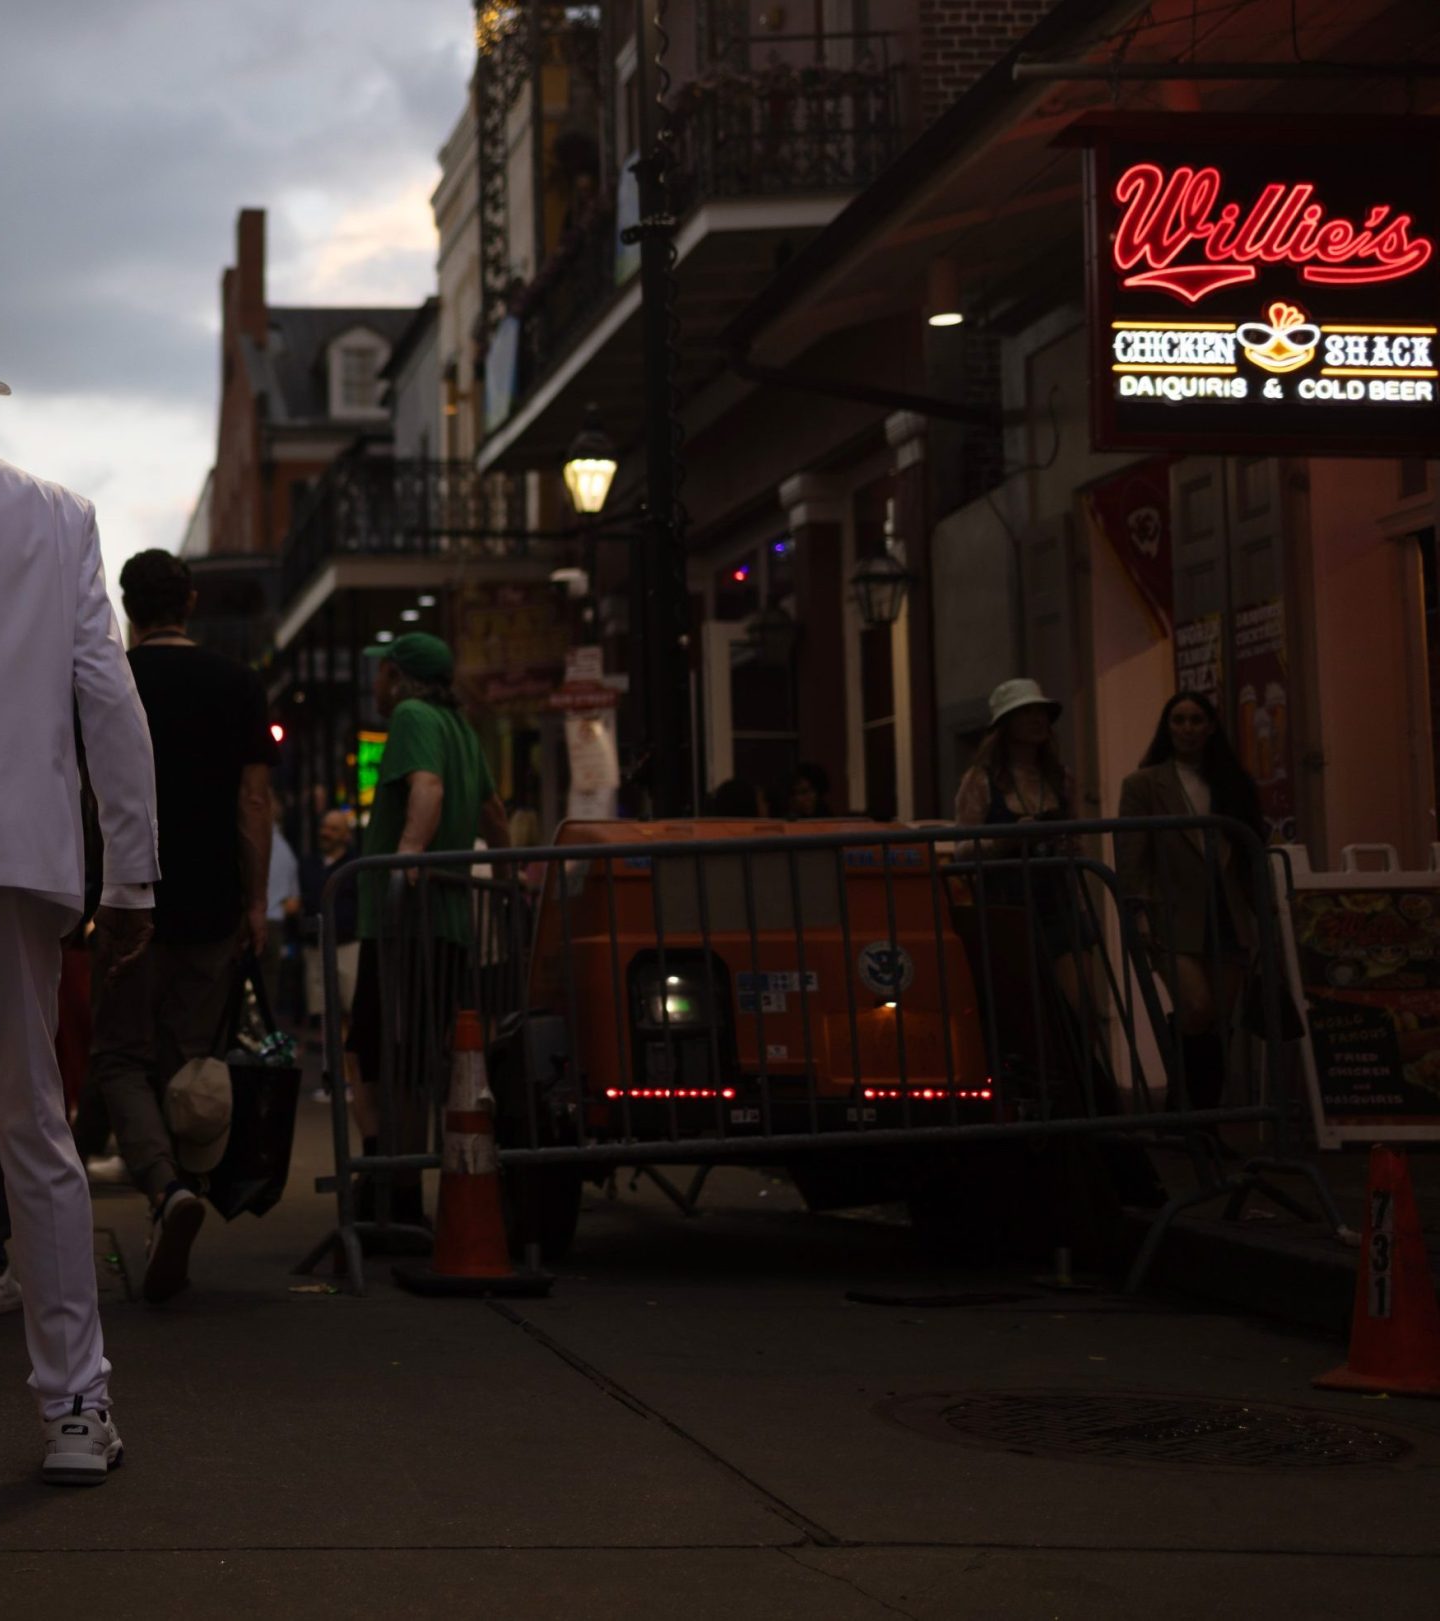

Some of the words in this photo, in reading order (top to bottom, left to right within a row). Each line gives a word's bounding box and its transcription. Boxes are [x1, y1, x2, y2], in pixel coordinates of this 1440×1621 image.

[1114, 162, 1432, 275] Willie's
[1113, 330, 1237, 364] CHICKEN
[1324, 334, 1433, 368] SHACK
[1120, 375, 1247, 400] DAIQUIRIS
[1263, 377, 1283, 399] &
[1298, 379, 1365, 400] COLD
[1369, 380, 1433, 401] BEER
[1333, 1052, 1379, 1063] FRIED
[1327, 1066, 1391, 1077] CHICKEN
[1324, 1093, 1405, 1105] DAIQUIRIS
[1371, 1187, 1391, 1316] 731
